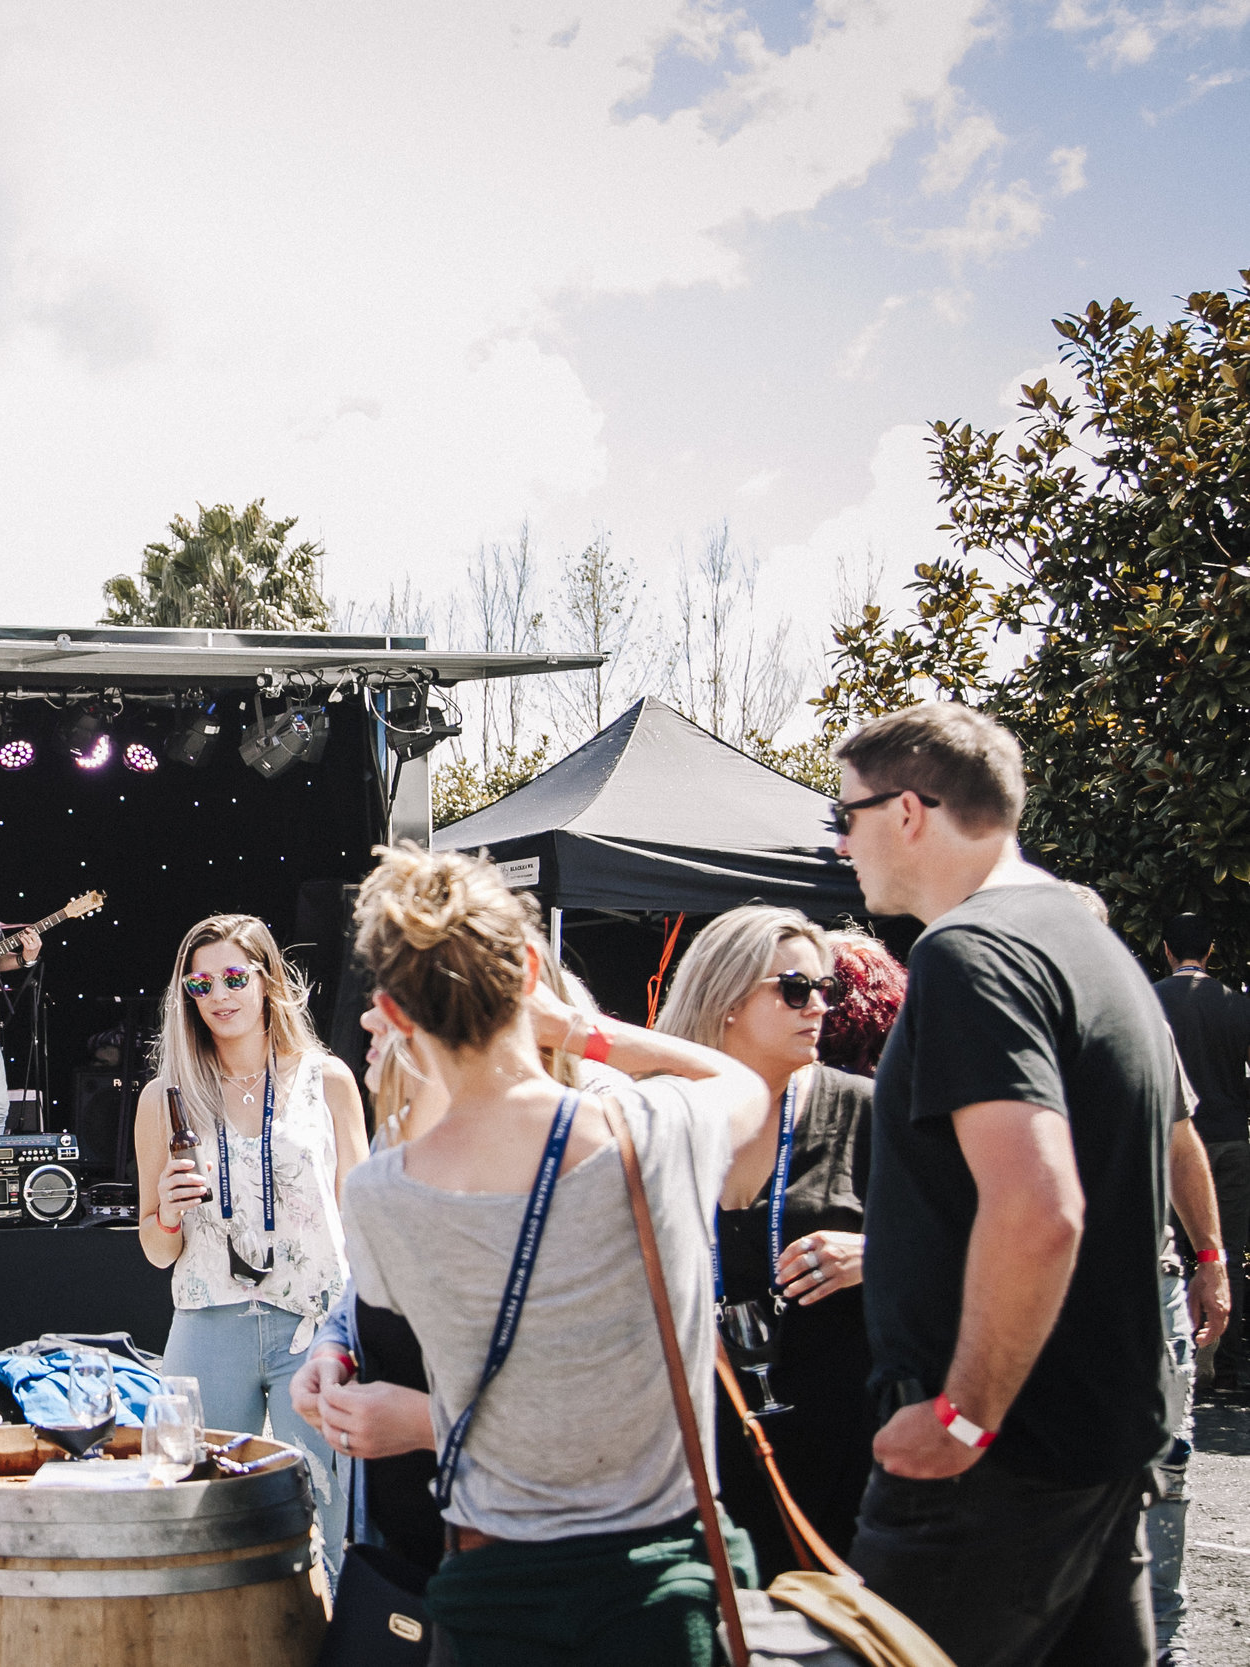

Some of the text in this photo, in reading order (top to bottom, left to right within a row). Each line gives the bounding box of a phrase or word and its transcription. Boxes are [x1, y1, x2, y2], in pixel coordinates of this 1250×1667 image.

[263, 1115, 271, 1140] FESTIVAL
[782, 1096, 793, 1133] MATAKANA
[218, 1135, 226, 1158] OYSTER
[777, 1144, 788, 1176] FESTIVAL
[221, 1178, 229, 1207] FESTIVAL
[774, 1177, 784, 1196] WINE
[771, 1200, 780, 1229] OYSTER
[771, 1230, 781, 1274] MATAKANA
